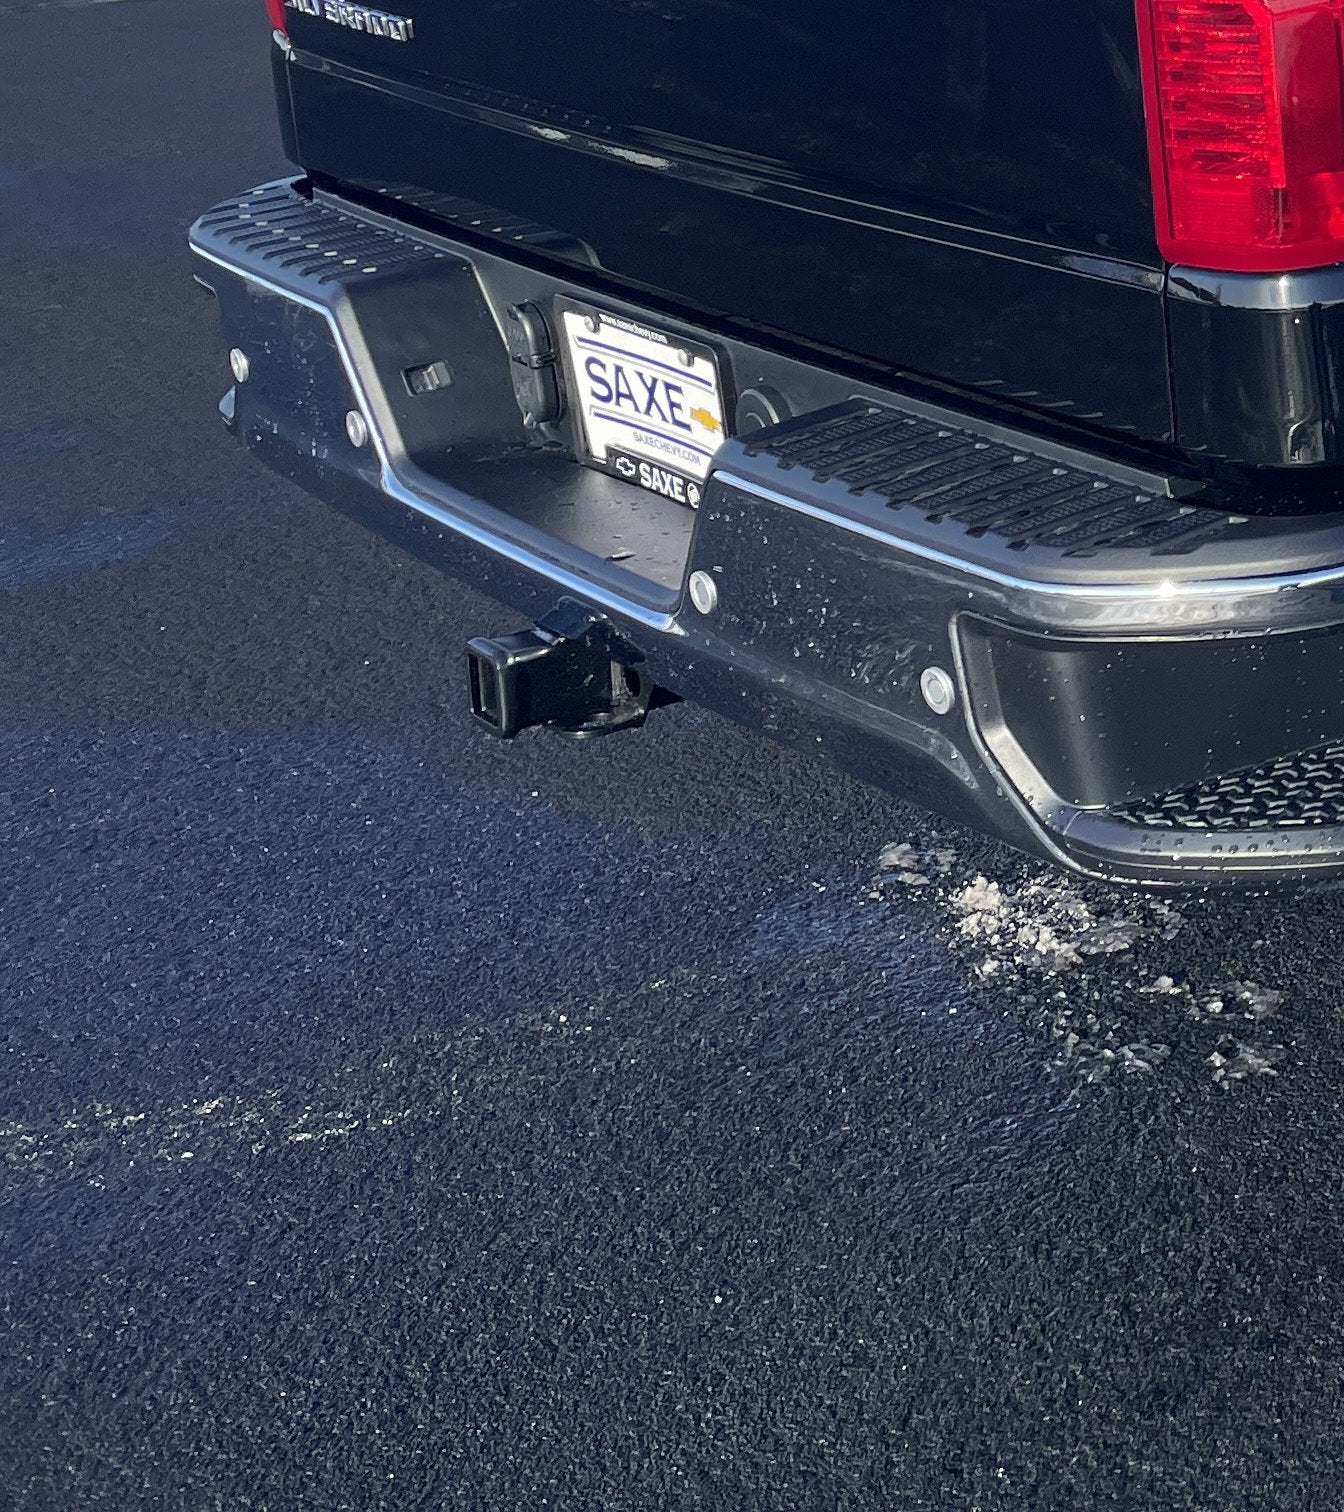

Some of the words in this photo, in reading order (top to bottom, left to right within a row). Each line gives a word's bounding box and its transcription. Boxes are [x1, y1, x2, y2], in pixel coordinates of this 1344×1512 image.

[584, 355, 693, 433] SAXE
[632, 431, 702, 466] SAXECHEVY.COM
[638, 462, 686, 503] SAXE
